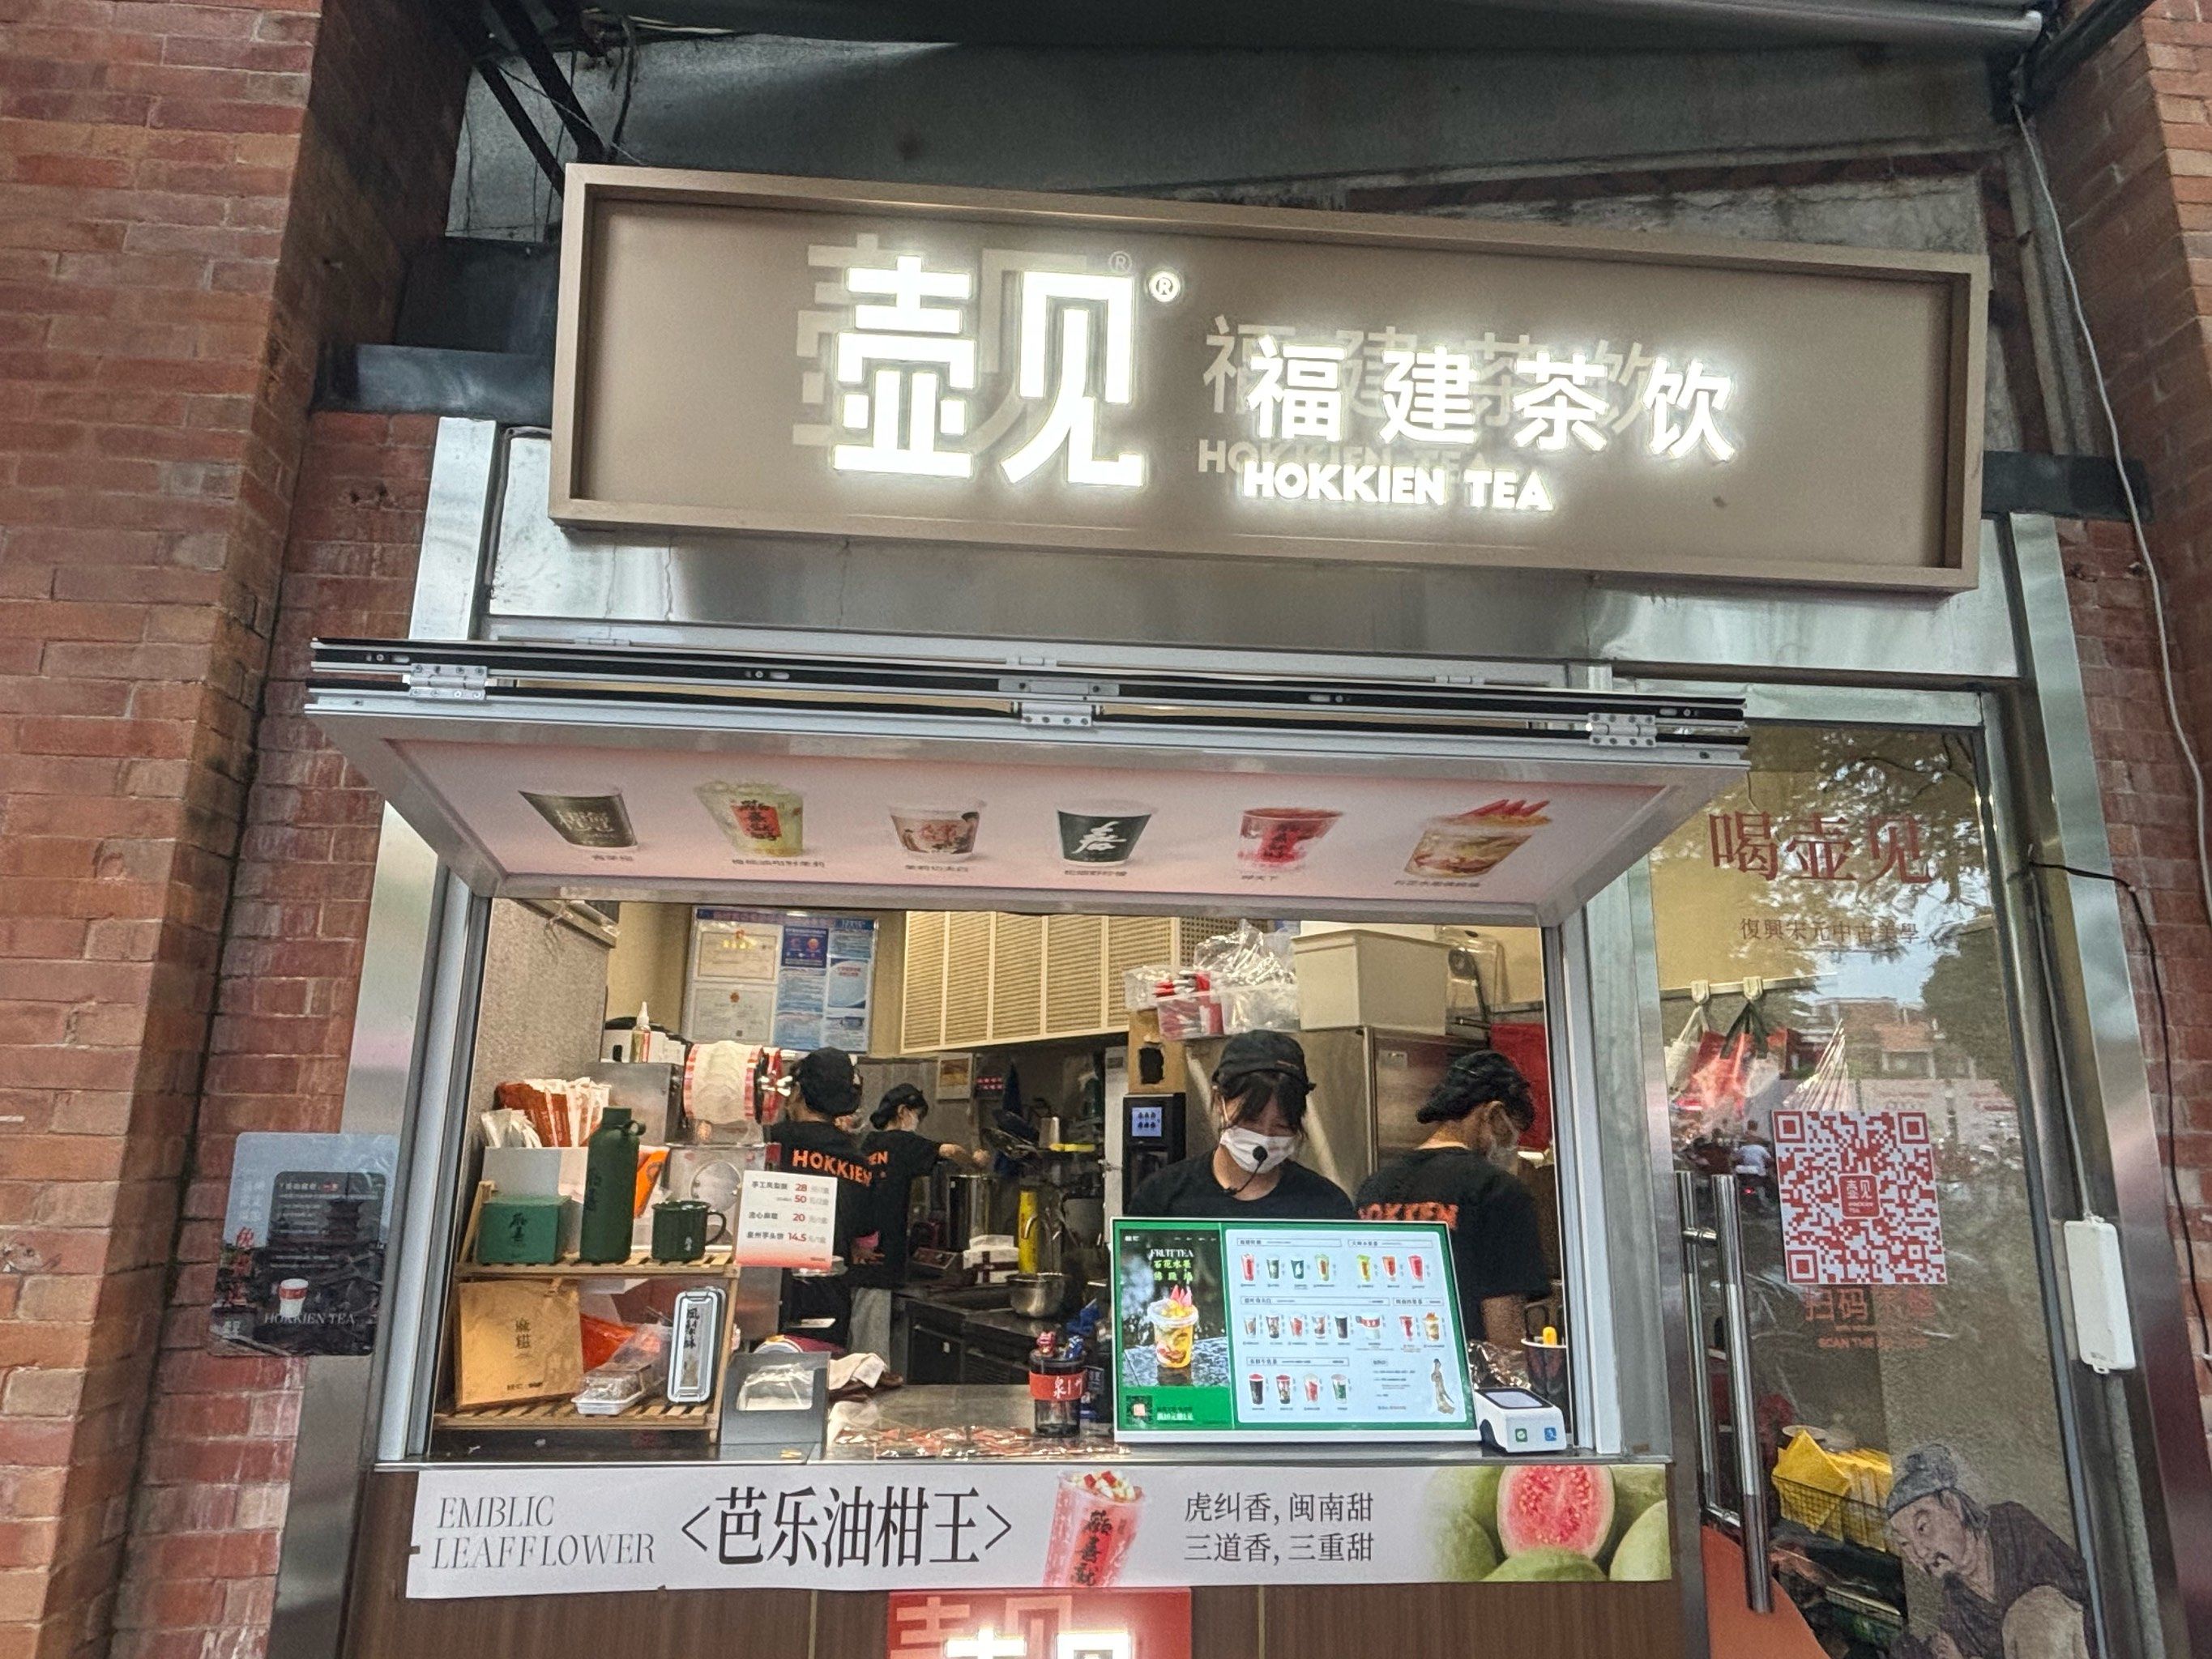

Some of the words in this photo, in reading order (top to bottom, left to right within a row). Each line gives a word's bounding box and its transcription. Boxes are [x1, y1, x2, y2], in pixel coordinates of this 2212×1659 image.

[833, 255, 1144, 487] 壶见
[1247, 335, 1736, 462] 福建茶饮
[1243, 459, 1446, 506] HOKKIEN
[1463, 467, 1554, 512] TEA
[1709, 811, 1934, 885] 喝壶见
[792, 1148, 873, 1187] HOKKIEN
[794, 1195, 807, 1204] 50
[795, 1183, 808, 1192] 28
[792, 1213, 805, 1222] 20
[788, 1232, 807, 1242] 14.5
[437, 1495, 555, 1529] EMBLIC
[430, 1533, 655, 1571] LEAFFLOWER
